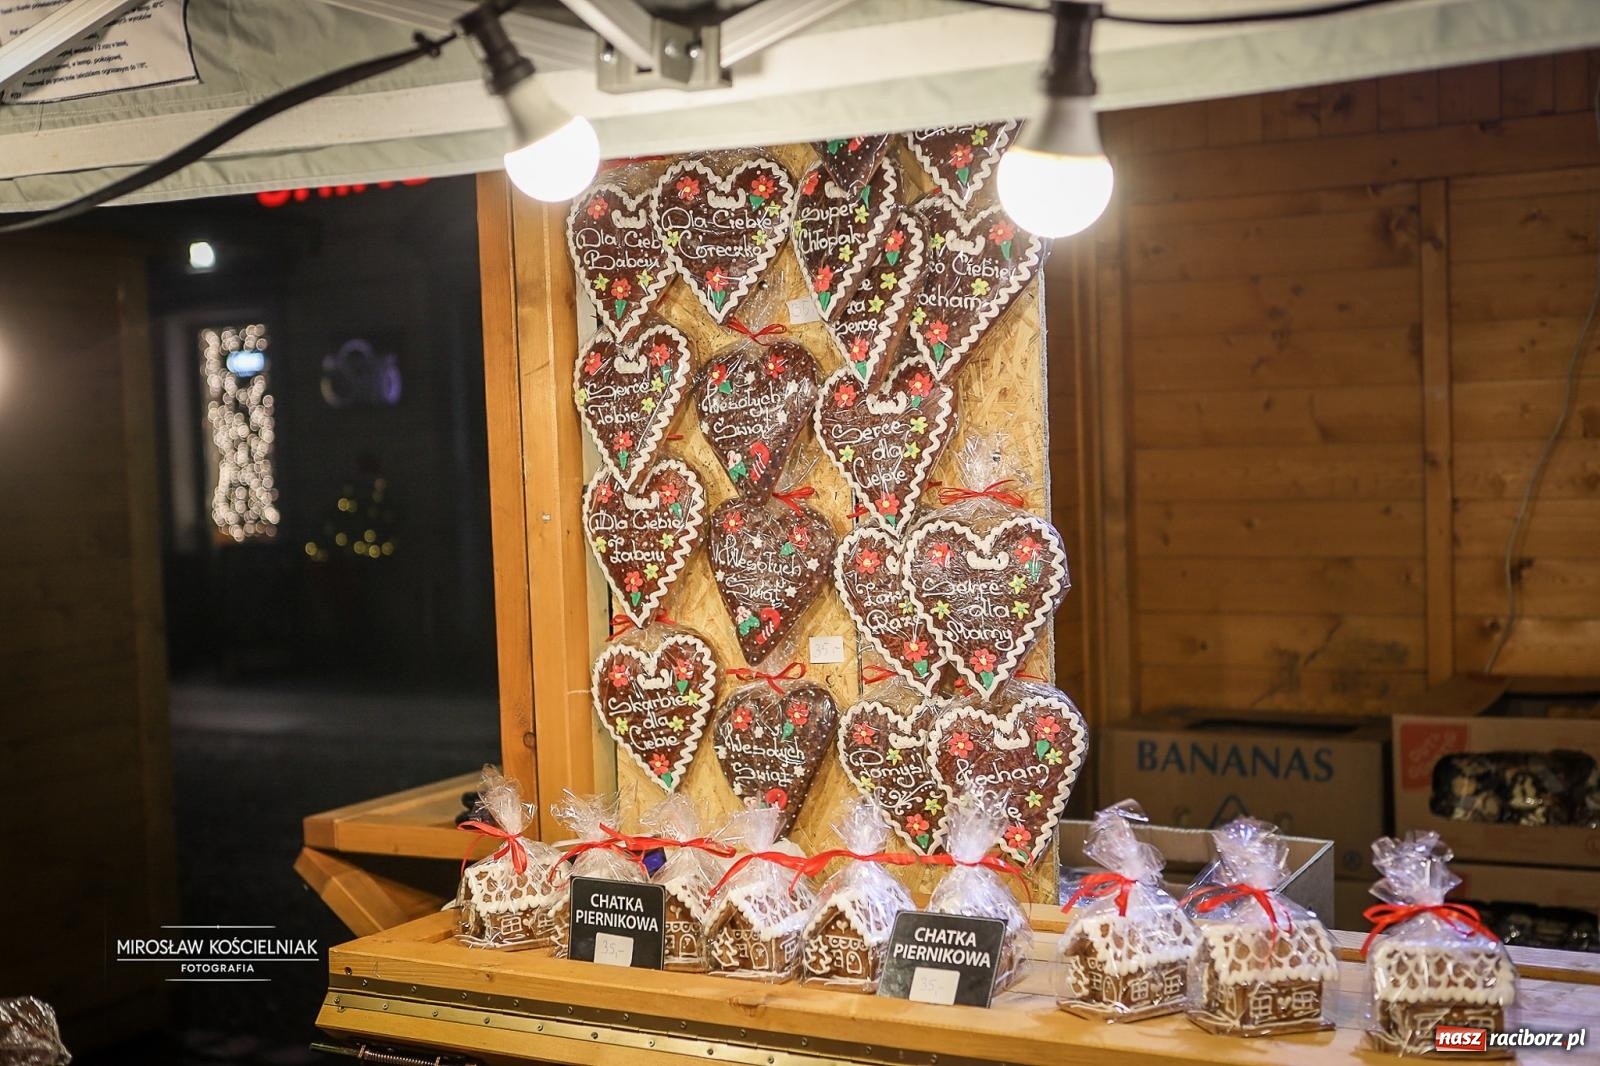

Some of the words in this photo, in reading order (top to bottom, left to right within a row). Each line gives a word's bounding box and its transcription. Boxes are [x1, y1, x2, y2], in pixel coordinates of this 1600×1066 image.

[661, 207, 708, 231] Dla
[713, 209, 772, 230] Ciebie
[800, 202, 858, 224] Super
[576, 228, 617, 249] Dla
[624, 230, 662, 248] Cieb
[679, 230, 761, 259] Córeczko
[584, 250, 660, 270] Babciu
[952, 253, 1009, 278] Ciebie
[917, 284, 982, 311] ocham
[585, 381, 651, 401] Serce
[588, 402, 645, 425] Tobie
[832, 421, 907, 446] Serce
[872, 439, 903, 460] dla
[853, 457, 907, 488] Ciebie
[589, 511, 628, 534] Dla
[633, 509, 682, 530] Ciebie
[922, 577, 1002, 597] Serce
[969, 596, 1010, 618] dla
[947, 620, 1014, 651] Mamy
[608, 691, 688, 716] Skarbie
[643, 711, 669, 729] dla
[629, 725, 680, 751] Ciebie
[1136, 739, 1335, 783] BANANAS
[590, 893, 644, 912] CHATKA
[575, 909, 659, 932] PIERNIKOWA
[914, 927, 977, 947] CHATKA
[893, 943, 991, 968] PIERNIKOWA
